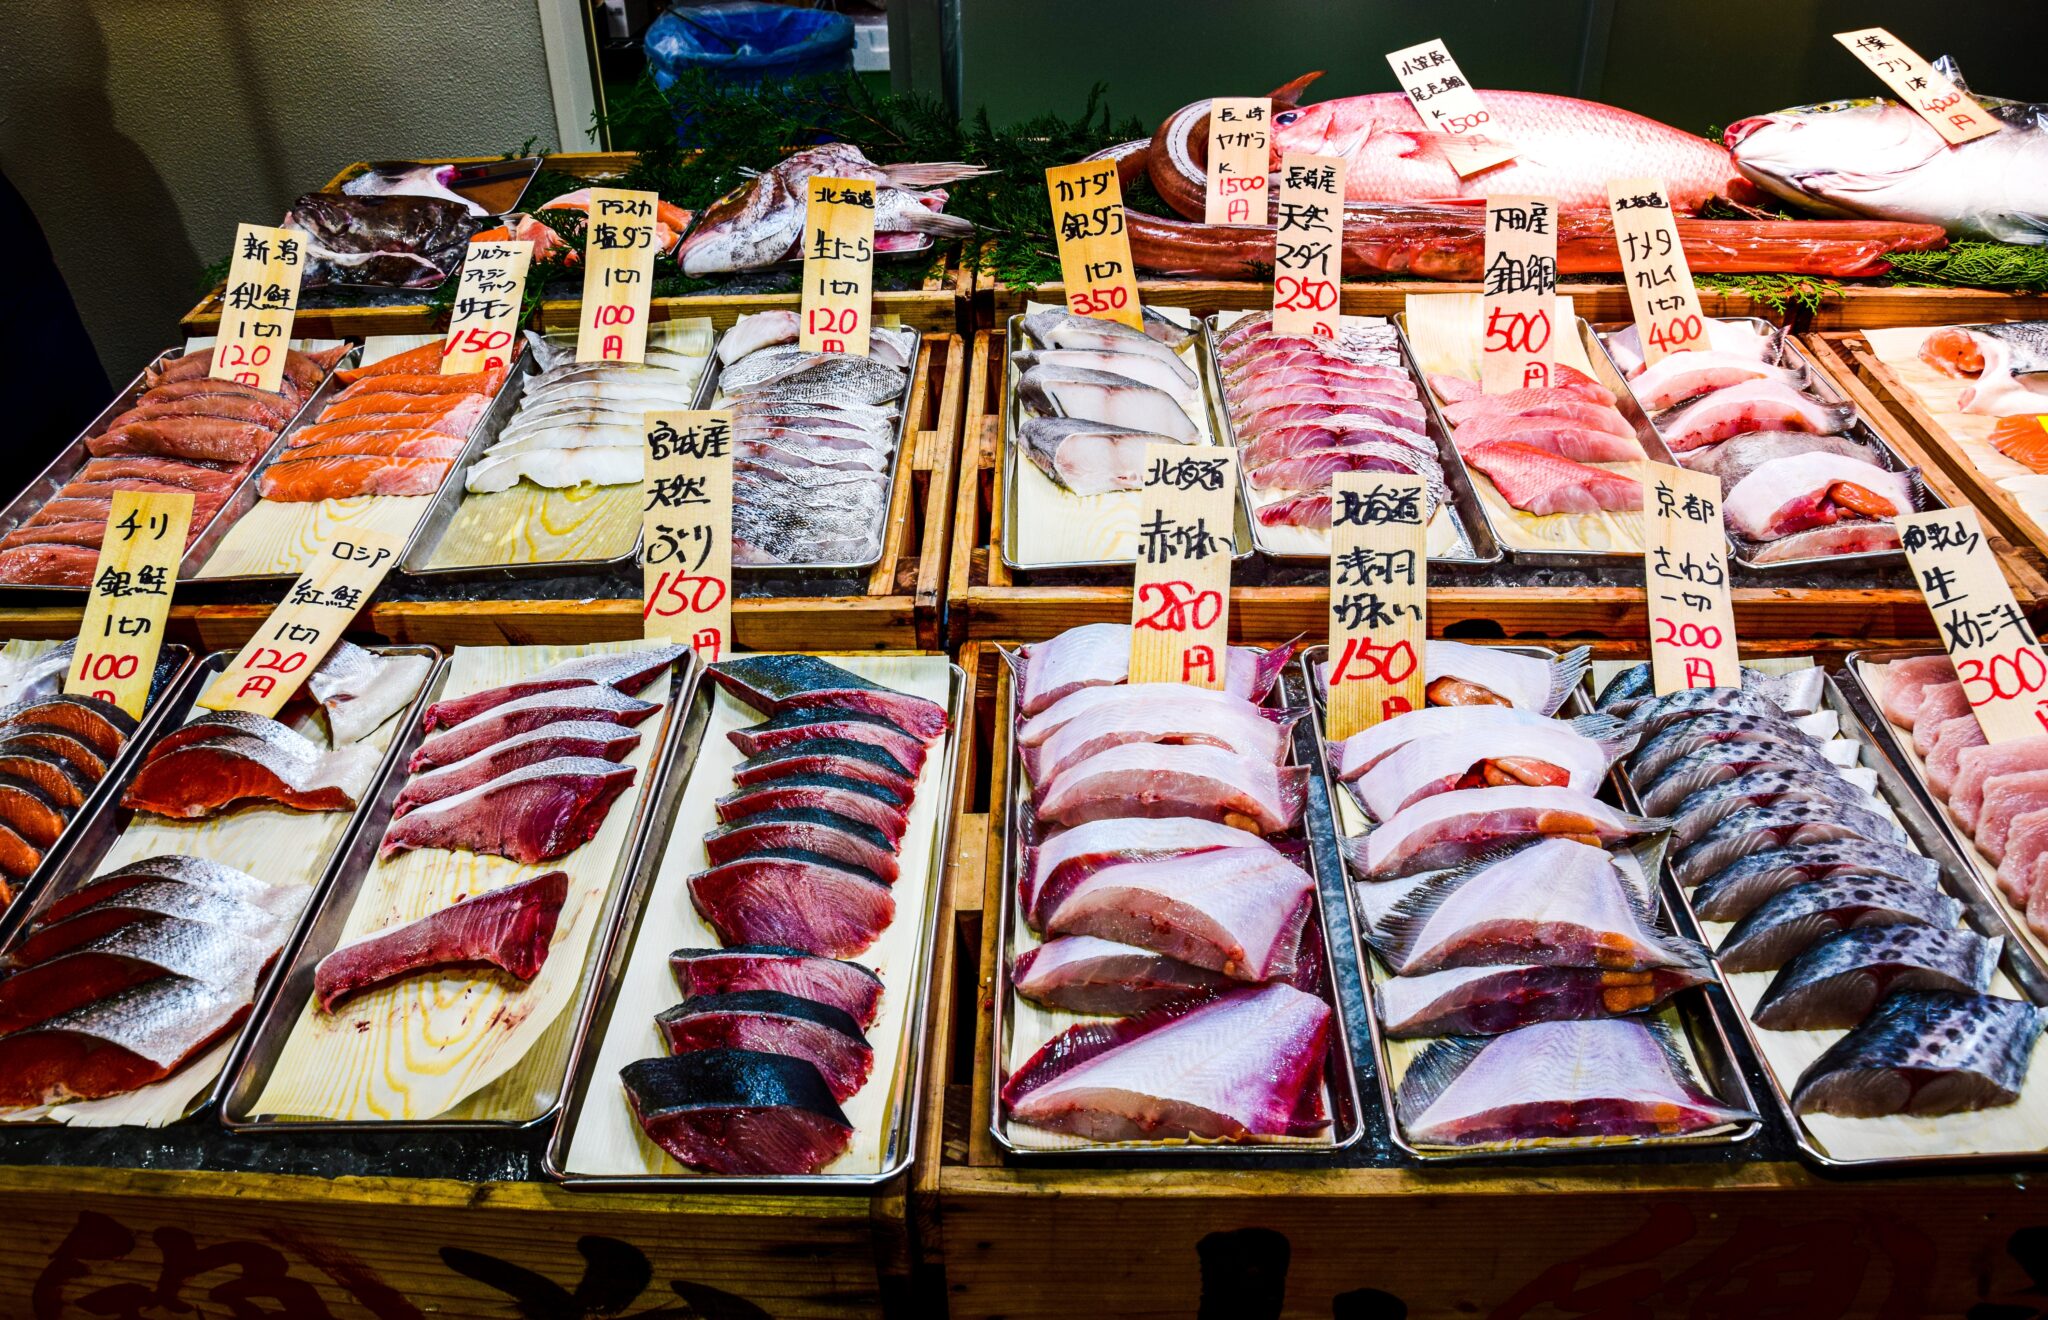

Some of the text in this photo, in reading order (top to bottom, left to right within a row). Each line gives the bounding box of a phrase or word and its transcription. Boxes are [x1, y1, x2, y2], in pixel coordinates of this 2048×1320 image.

[1877, 58, 1911, 73] ブリ
[1218, 106, 1265, 122] 長崎
[1440, 111, 1489, 134] 1500
[1949, 114, 1977, 131] 円
[1055, 169, 1114, 202] カナダ
[1285, 165, 1337, 194] 長崎産
[597, 200, 652, 217] アラスカ
[814, 187, 875, 209] 北海道
[1228, 199, 1249, 222] 円
[1061, 204, 1123, 242] 銀ダラ
[1278, 203, 1333, 232] 天然
[1490, 201, 1549, 235] 下田産
[243, 232, 298, 265] 新潟
[592, 223, 653, 249] 塩ダラ
[809, 228, 871, 263] 生たら
[1623, 229, 1672, 263] ナメタ
[467, 246, 522, 261] ノルウェー
[1276, 242, 1333, 276] マダイ
[605, 268, 640, 287] 1切
[820, 279, 859, 296] 1切
[1085, 261, 1122, 283] 1切
[1484, 251, 1557, 297] 金目鯛
[1635, 264, 1677, 289] カレイ
[230, 282, 294, 310] 秋鮭
[1070, 286, 1127, 315] 350
[1274, 276, 1338, 312] 250
[1648, 295, 1685, 316] 1切
[240, 322, 281, 337] 1切
[594, 305, 635, 329] 100
[809, 307, 858, 335] 120
[1484, 306, 1551, 354] 500
[442, 328, 511, 356] 150
[602, 335, 623, 360] 円
[1648, 314, 1702, 353] 400
[220, 345, 270, 368] 120
[1523, 361, 1549, 389] 円
[648, 419, 731, 461] 宮城産
[1144, 457, 1229, 492] 北海道
[643, 473, 712, 512] 天然
[1332, 483, 1423, 527] 北海道
[1654, 480, 1715, 524] 京都
[116, 509, 169, 541] チリ
[1902, 520, 1979, 555] 和歌山
[332, 541, 391, 568] ロシア
[646, 524, 714, 572] ぶり
[96, 564, 168, 597] 銀鮭
[1336, 545, 1416, 587] 浅羽
[1653, 545, 1724, 586] さわら
[290, 578, 362, 611] 紅鮭
[643, 569, 726, 620] 150
[1660, 592, 1712, 612] 一切
[1922, 566, 1969, 609] 生
[1134, 580, 1223, 633] 280
[104, 614, 151, 637] 1切
[274, 622, 320, 645] 1切
[1655, 617, 1722, 650] 200
[1943, 603, 2035, 654] メカジキ
[244, 648, 308, 674] 120
[692, 627, 721, 663] 円
[1329, 636, 1418, 686] 150
[79, 652, 139, 681] 100
[1182, 644, 1216, 683] 円
[1683, 657, 1716, 689] 円
[1957, 646, 2047, 707] 300
[236, 676, 277, 699] 円
